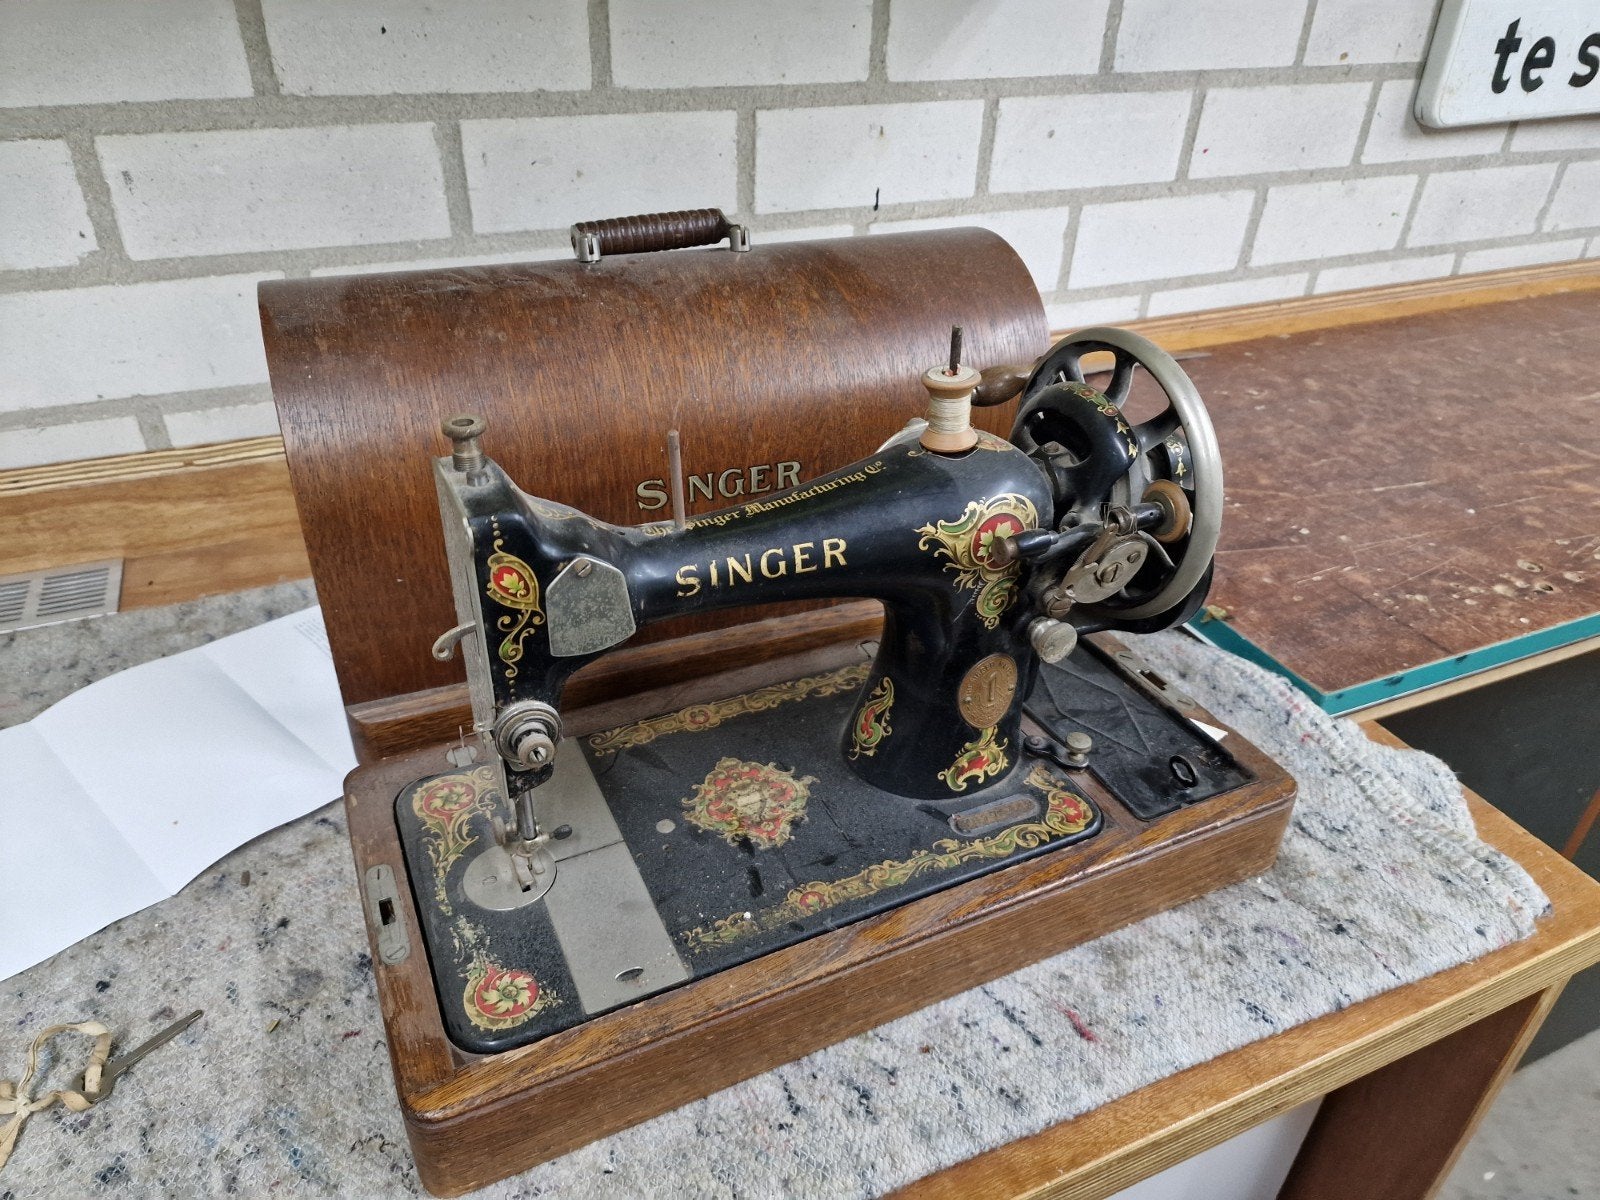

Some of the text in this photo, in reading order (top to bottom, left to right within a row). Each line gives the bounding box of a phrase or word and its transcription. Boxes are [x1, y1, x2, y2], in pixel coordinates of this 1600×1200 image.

[636, 460, 802, 510] SNGER
[745, 473, 867, 518] Manufacturing
[675, 538, 848, 597] SINGER
